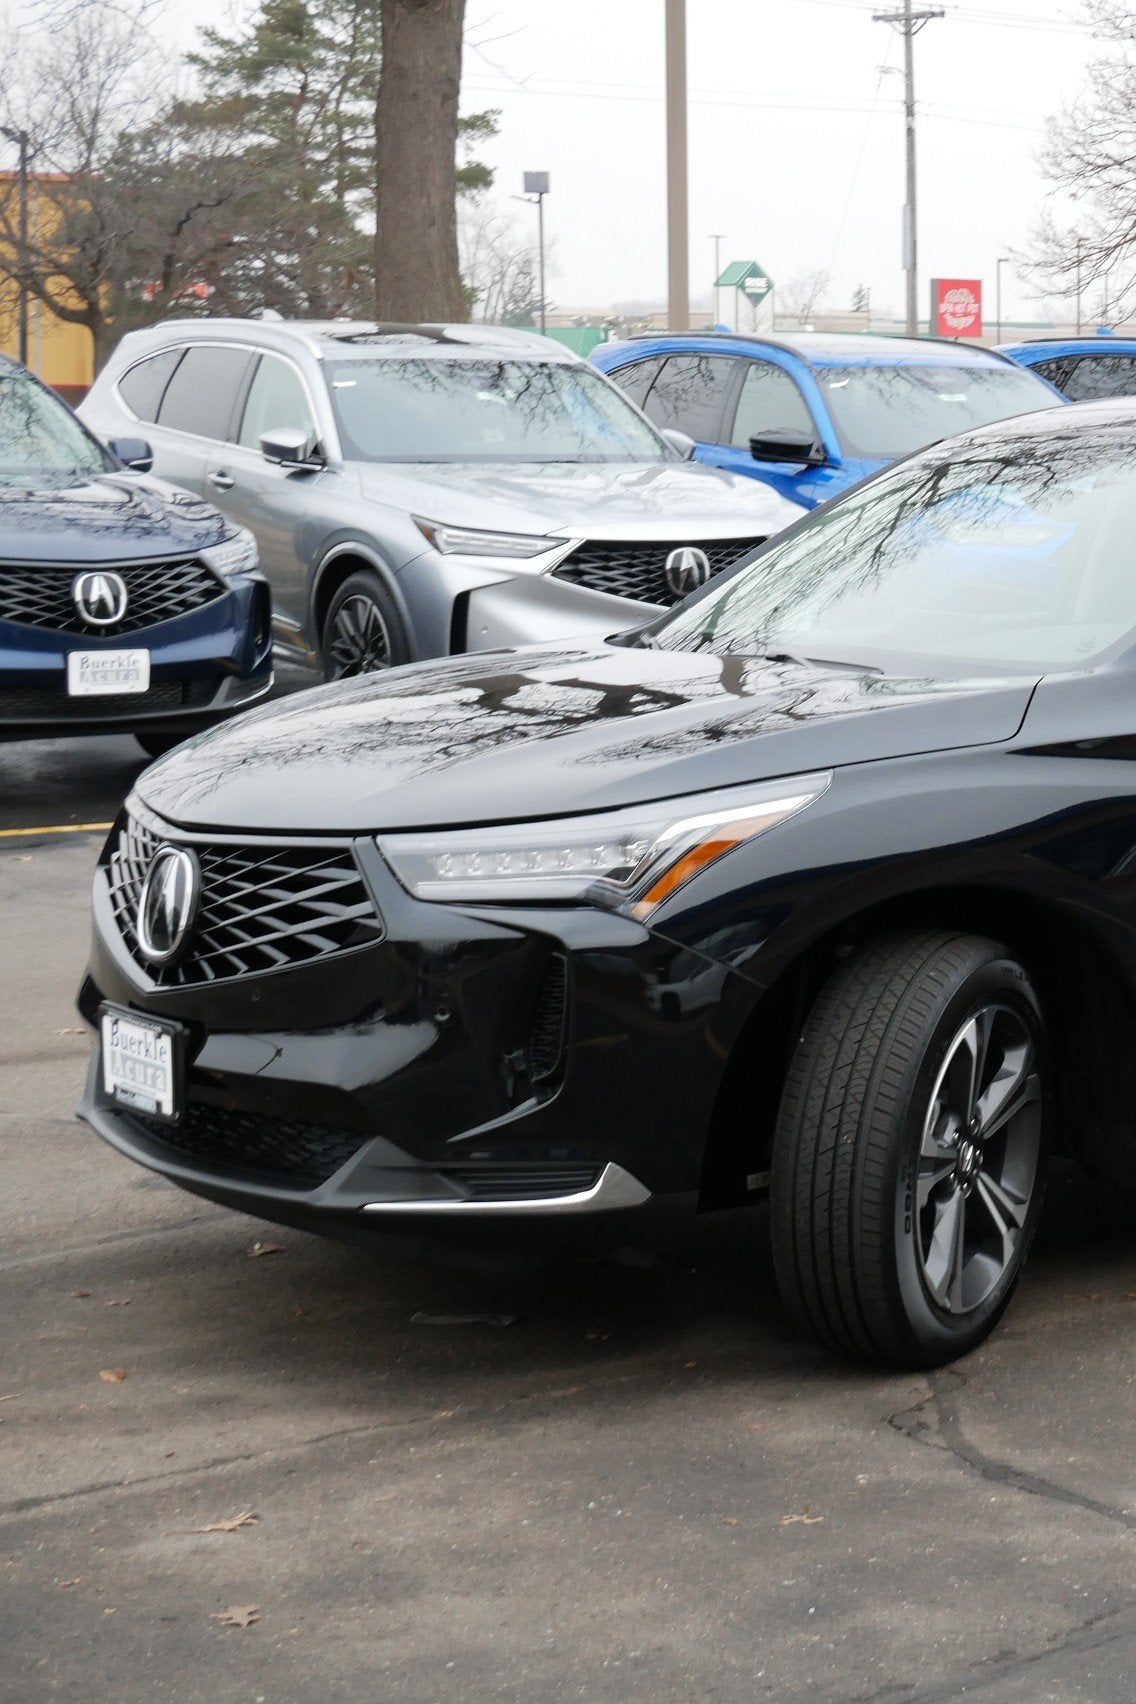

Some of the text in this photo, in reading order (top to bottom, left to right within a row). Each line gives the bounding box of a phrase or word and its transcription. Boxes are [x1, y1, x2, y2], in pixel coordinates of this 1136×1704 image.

[80, 653, 140, 670] Buerkle
[111, 1022, 167, 1065] Buerkle
[111, 1051, 166, 1093] Acura
